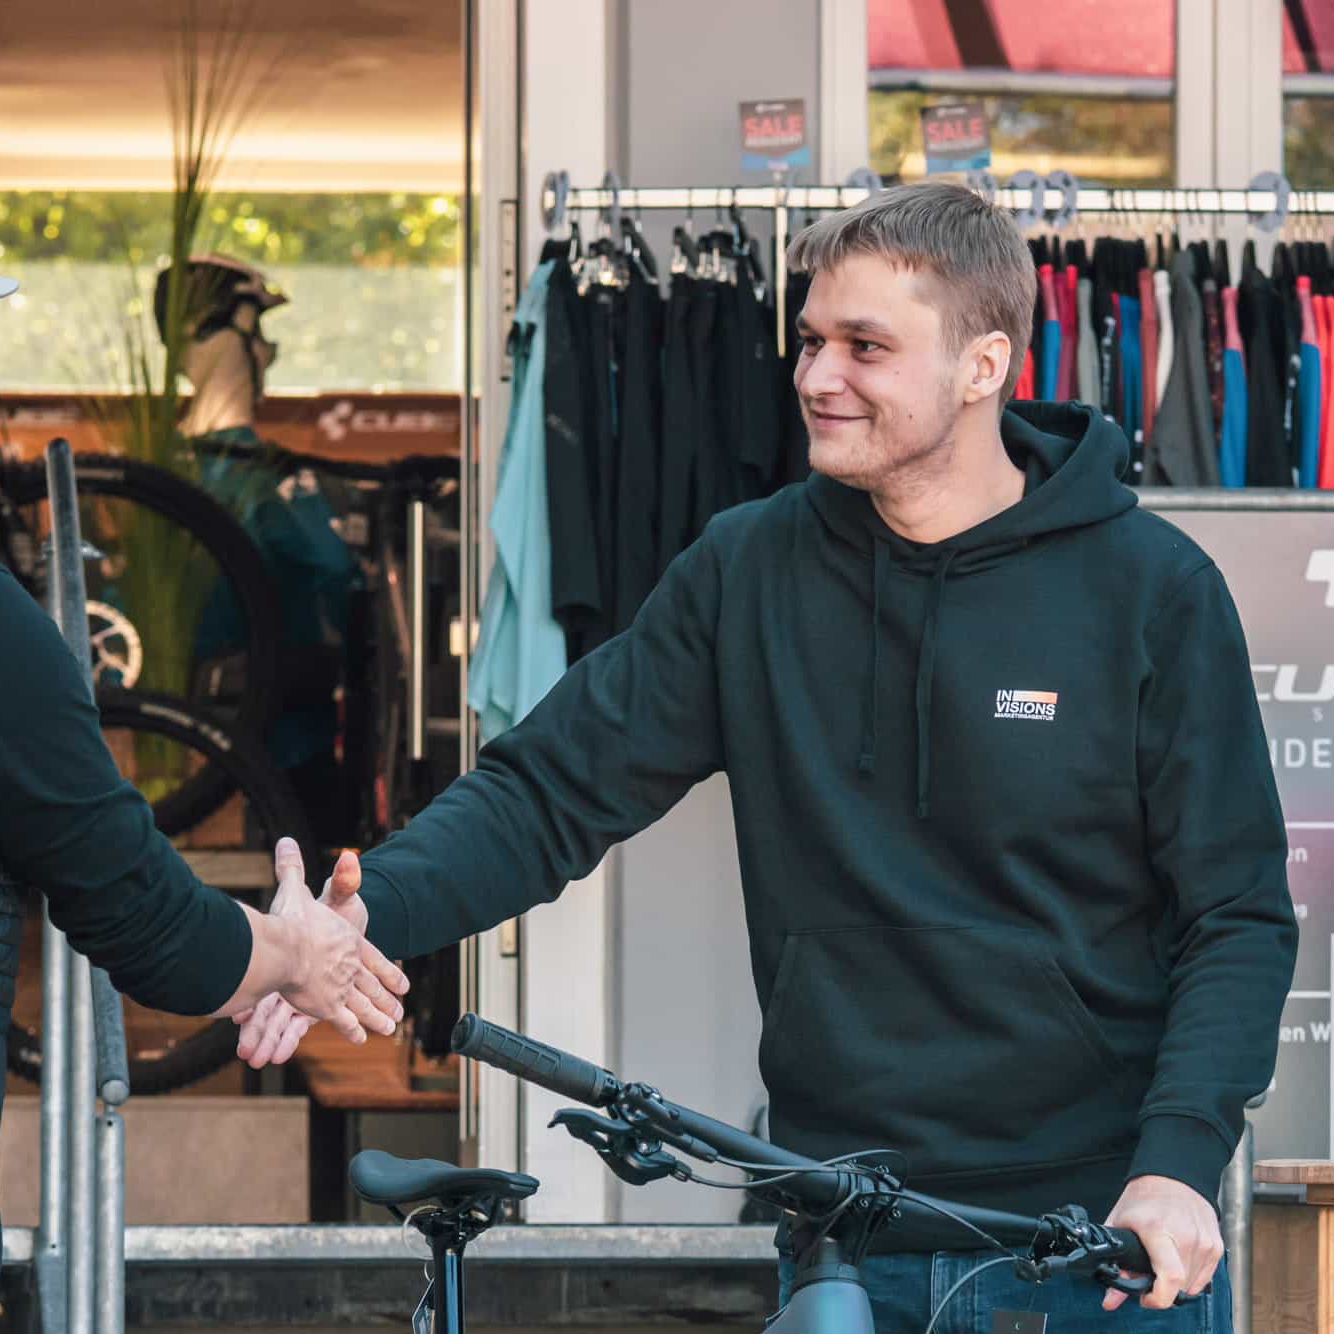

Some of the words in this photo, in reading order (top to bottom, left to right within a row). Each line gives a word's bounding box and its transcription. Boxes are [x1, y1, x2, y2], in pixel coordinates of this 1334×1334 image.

[744, 114, 804, 138] SALE
[926, 117, 984, 142] SALE
[996, 701, 1056, 716] VISIONS
